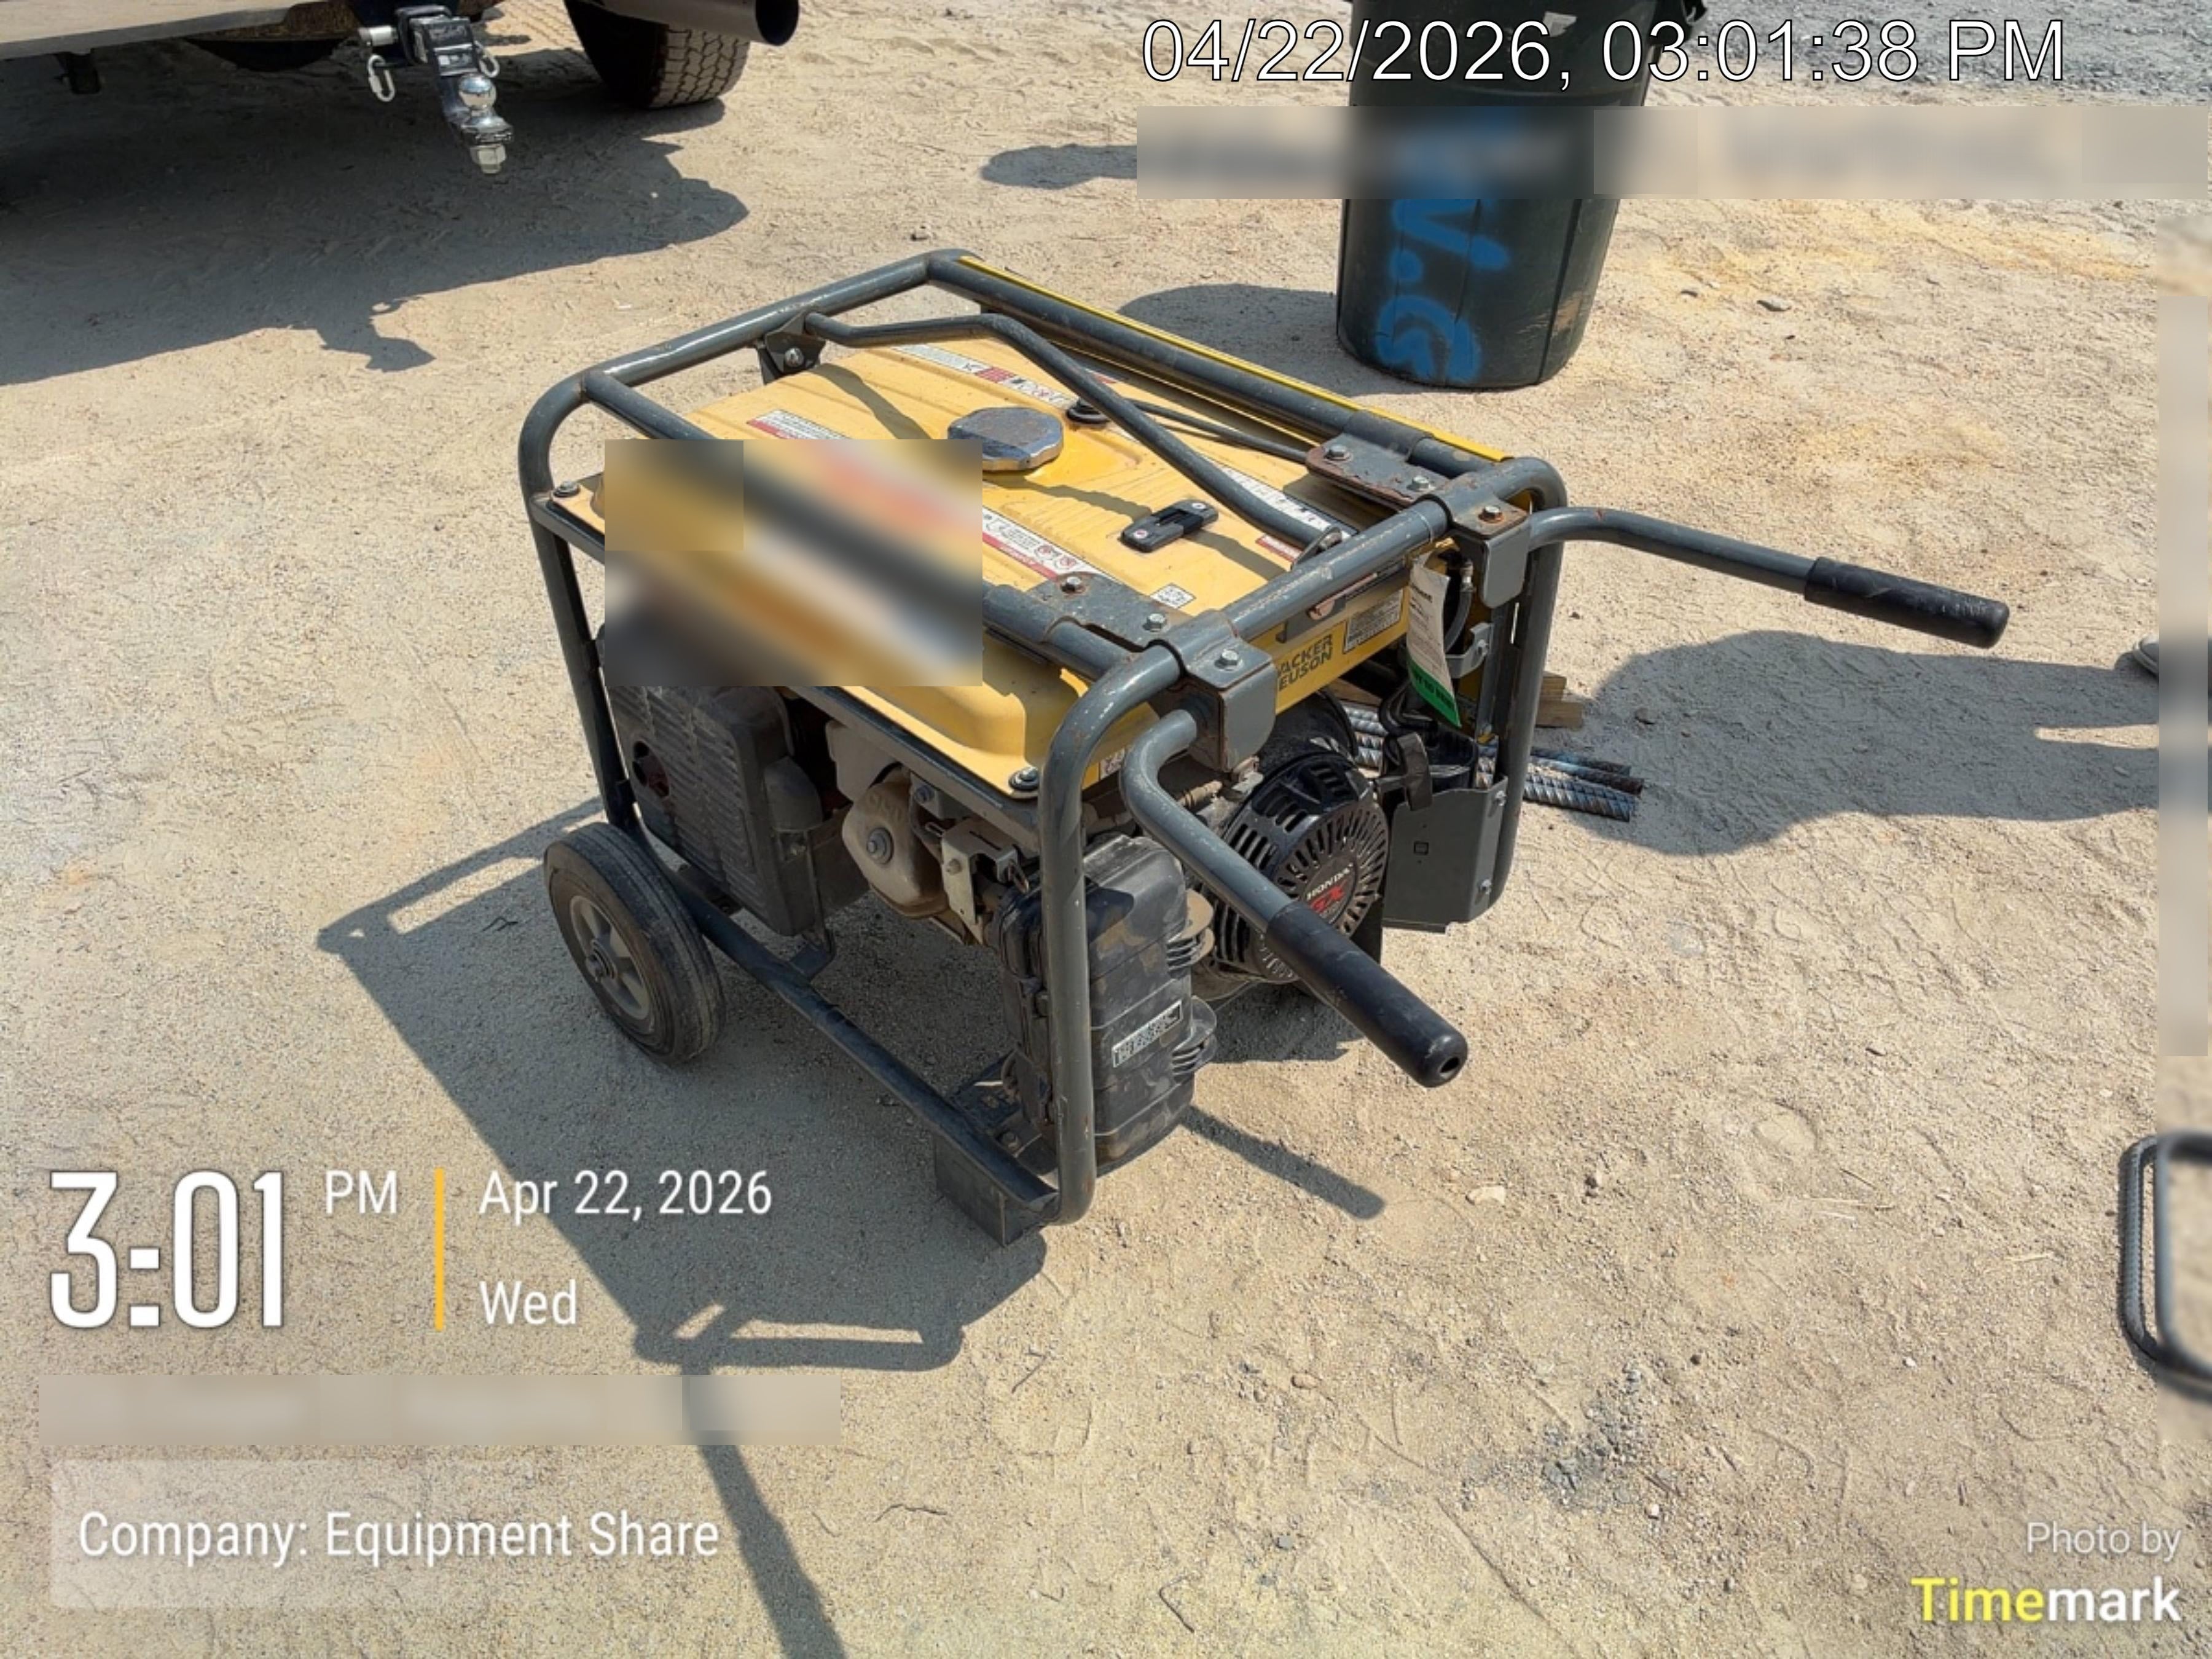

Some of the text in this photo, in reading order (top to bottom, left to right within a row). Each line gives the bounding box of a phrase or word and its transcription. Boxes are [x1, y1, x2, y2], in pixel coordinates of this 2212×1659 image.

[1278, 634, 1332, 676] ACKER
[1278, 646, 1332, 691] EUSON
[1306, 866, 1351, 901] HONDA
